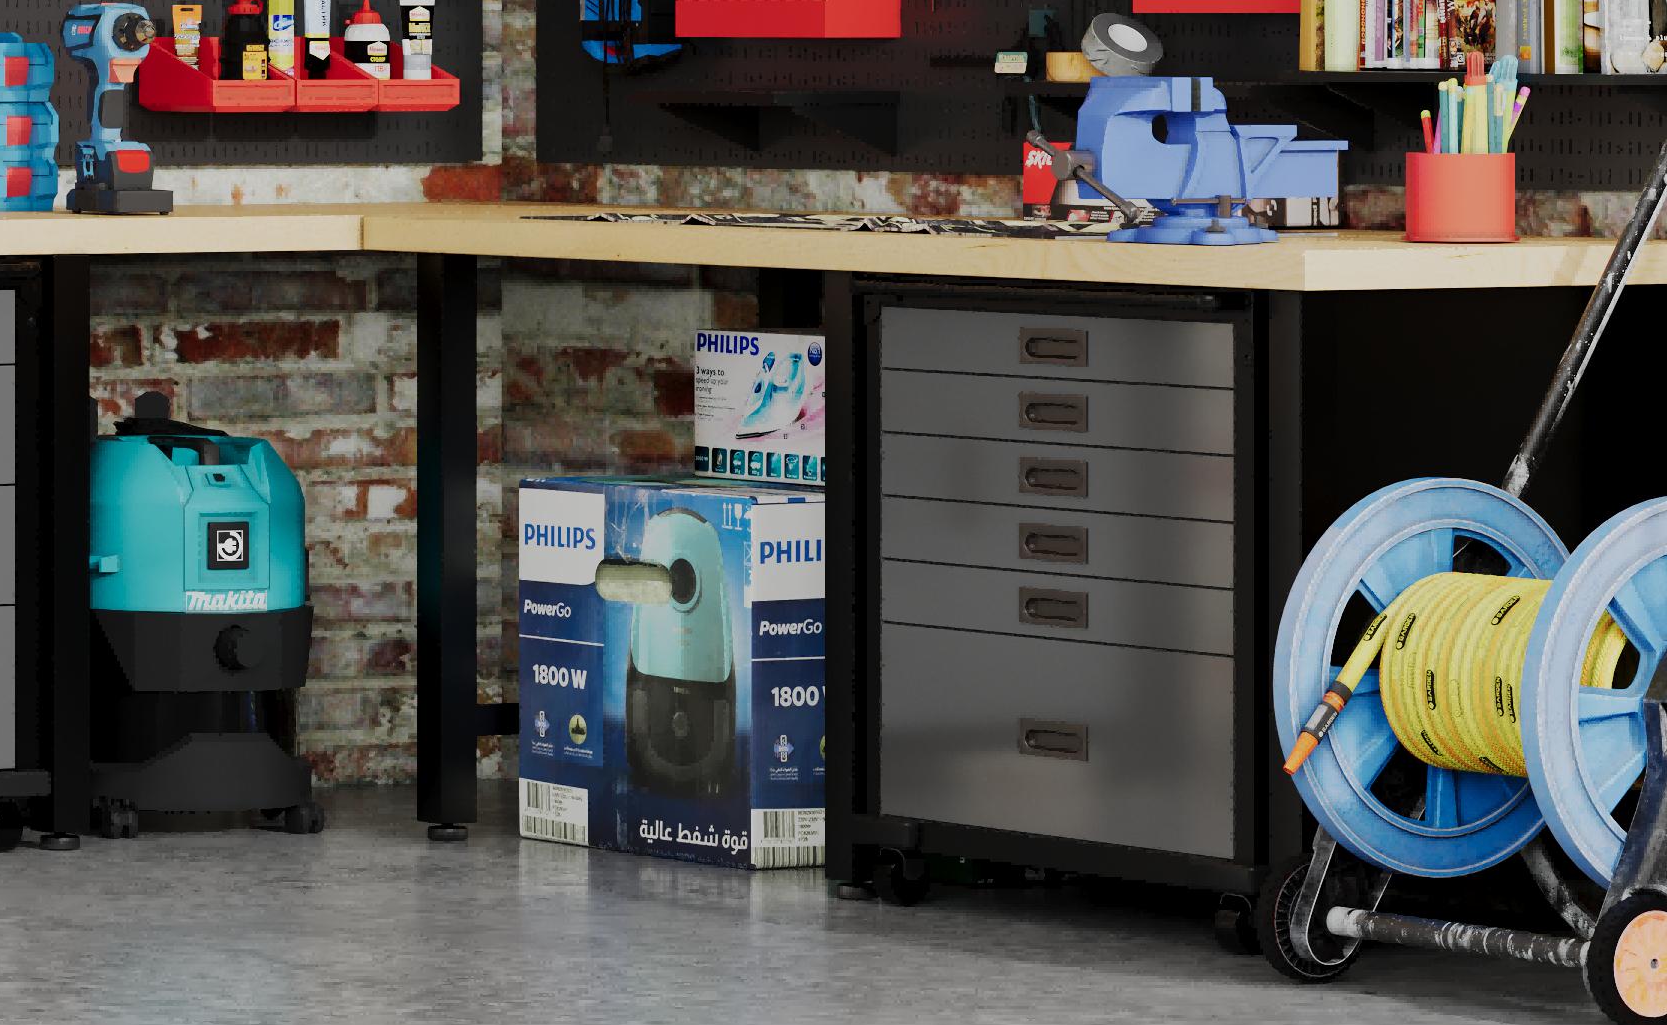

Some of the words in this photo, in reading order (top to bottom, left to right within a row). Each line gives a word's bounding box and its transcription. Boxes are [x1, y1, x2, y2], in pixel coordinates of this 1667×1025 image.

[697, 333, 760, 355] PHILIPS
[695, 377, 709, 385] speed
[696, 366, 700, 374] 3
[700, 368, 716, 377] ways
[524, 523, 596, 550] PHILIPS
[760, 539, 822, 564] PHILI
[186, 590, 267, 611] Makita
[523, 599, 571, 618] PowerGo
[759, 618, 822, 636] PowerGo
[532, 664, 569, 687] 1800
[571, 669, 587, 689] W
[771, 685, 819, 707] 1800
[639, 819, 672, 843] عالية
[676, 823, 718, 847] شفط
[722, 830, 748, 855] قوة
